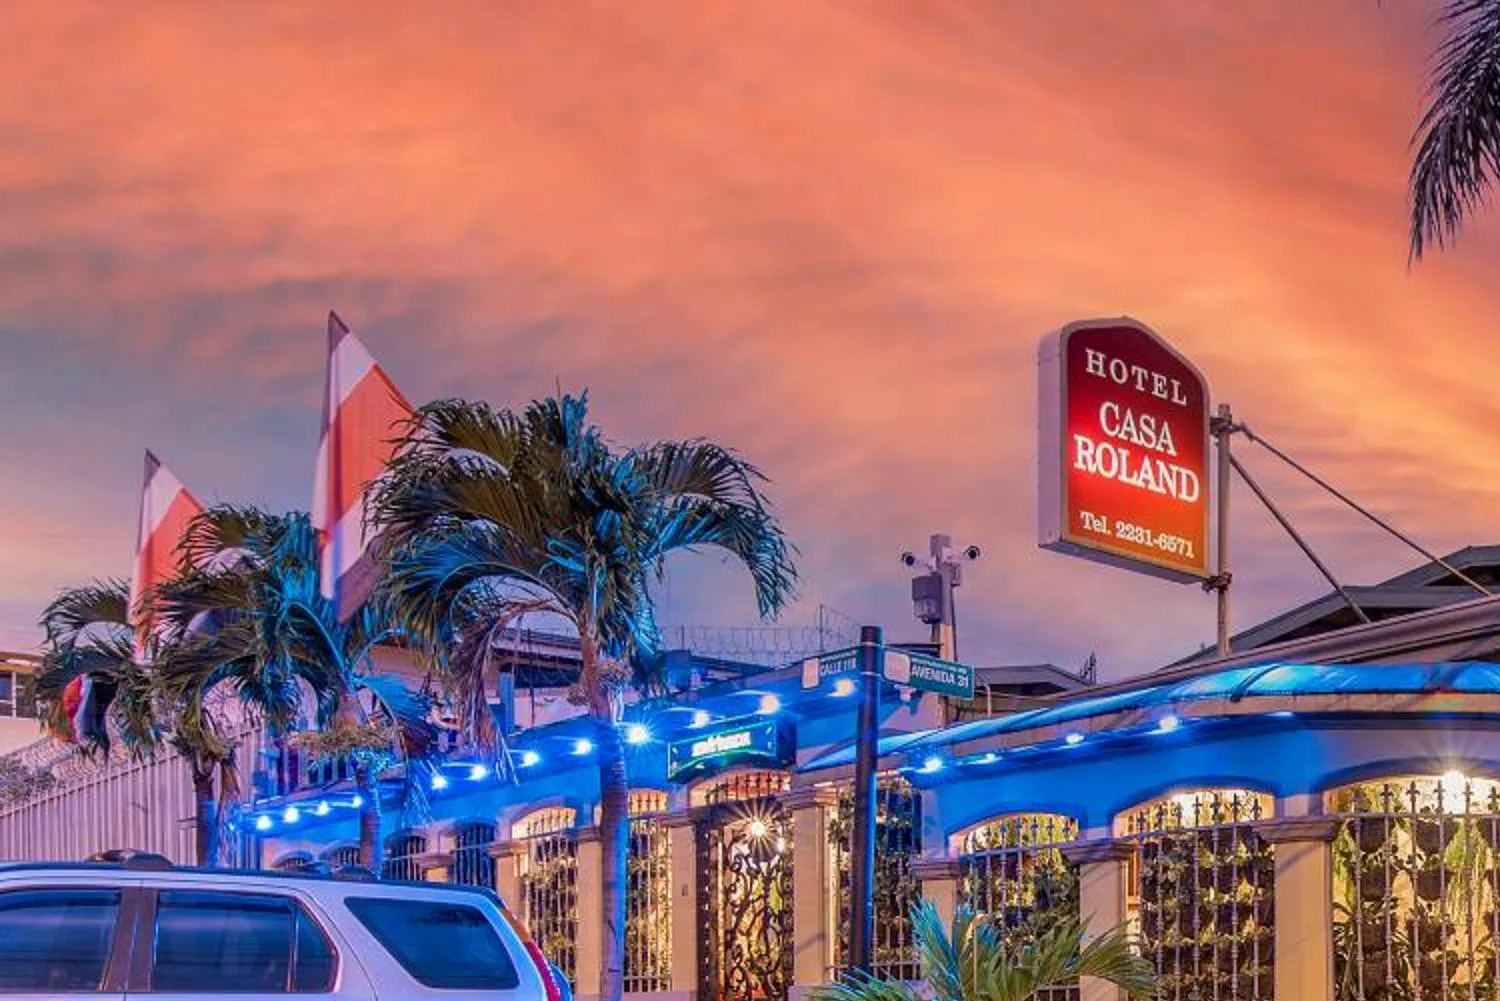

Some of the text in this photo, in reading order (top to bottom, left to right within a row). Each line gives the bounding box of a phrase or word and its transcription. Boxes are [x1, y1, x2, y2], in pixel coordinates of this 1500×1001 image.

[1084, 347, 1188, 407] HOTEL
[1099, 401, 1177, 457] CASA
[1073, 433, 1200, 503] ROLAND
[1079, 510, 1111, 536] Tel.
[911, 664, 956, 685] AVENIDA
